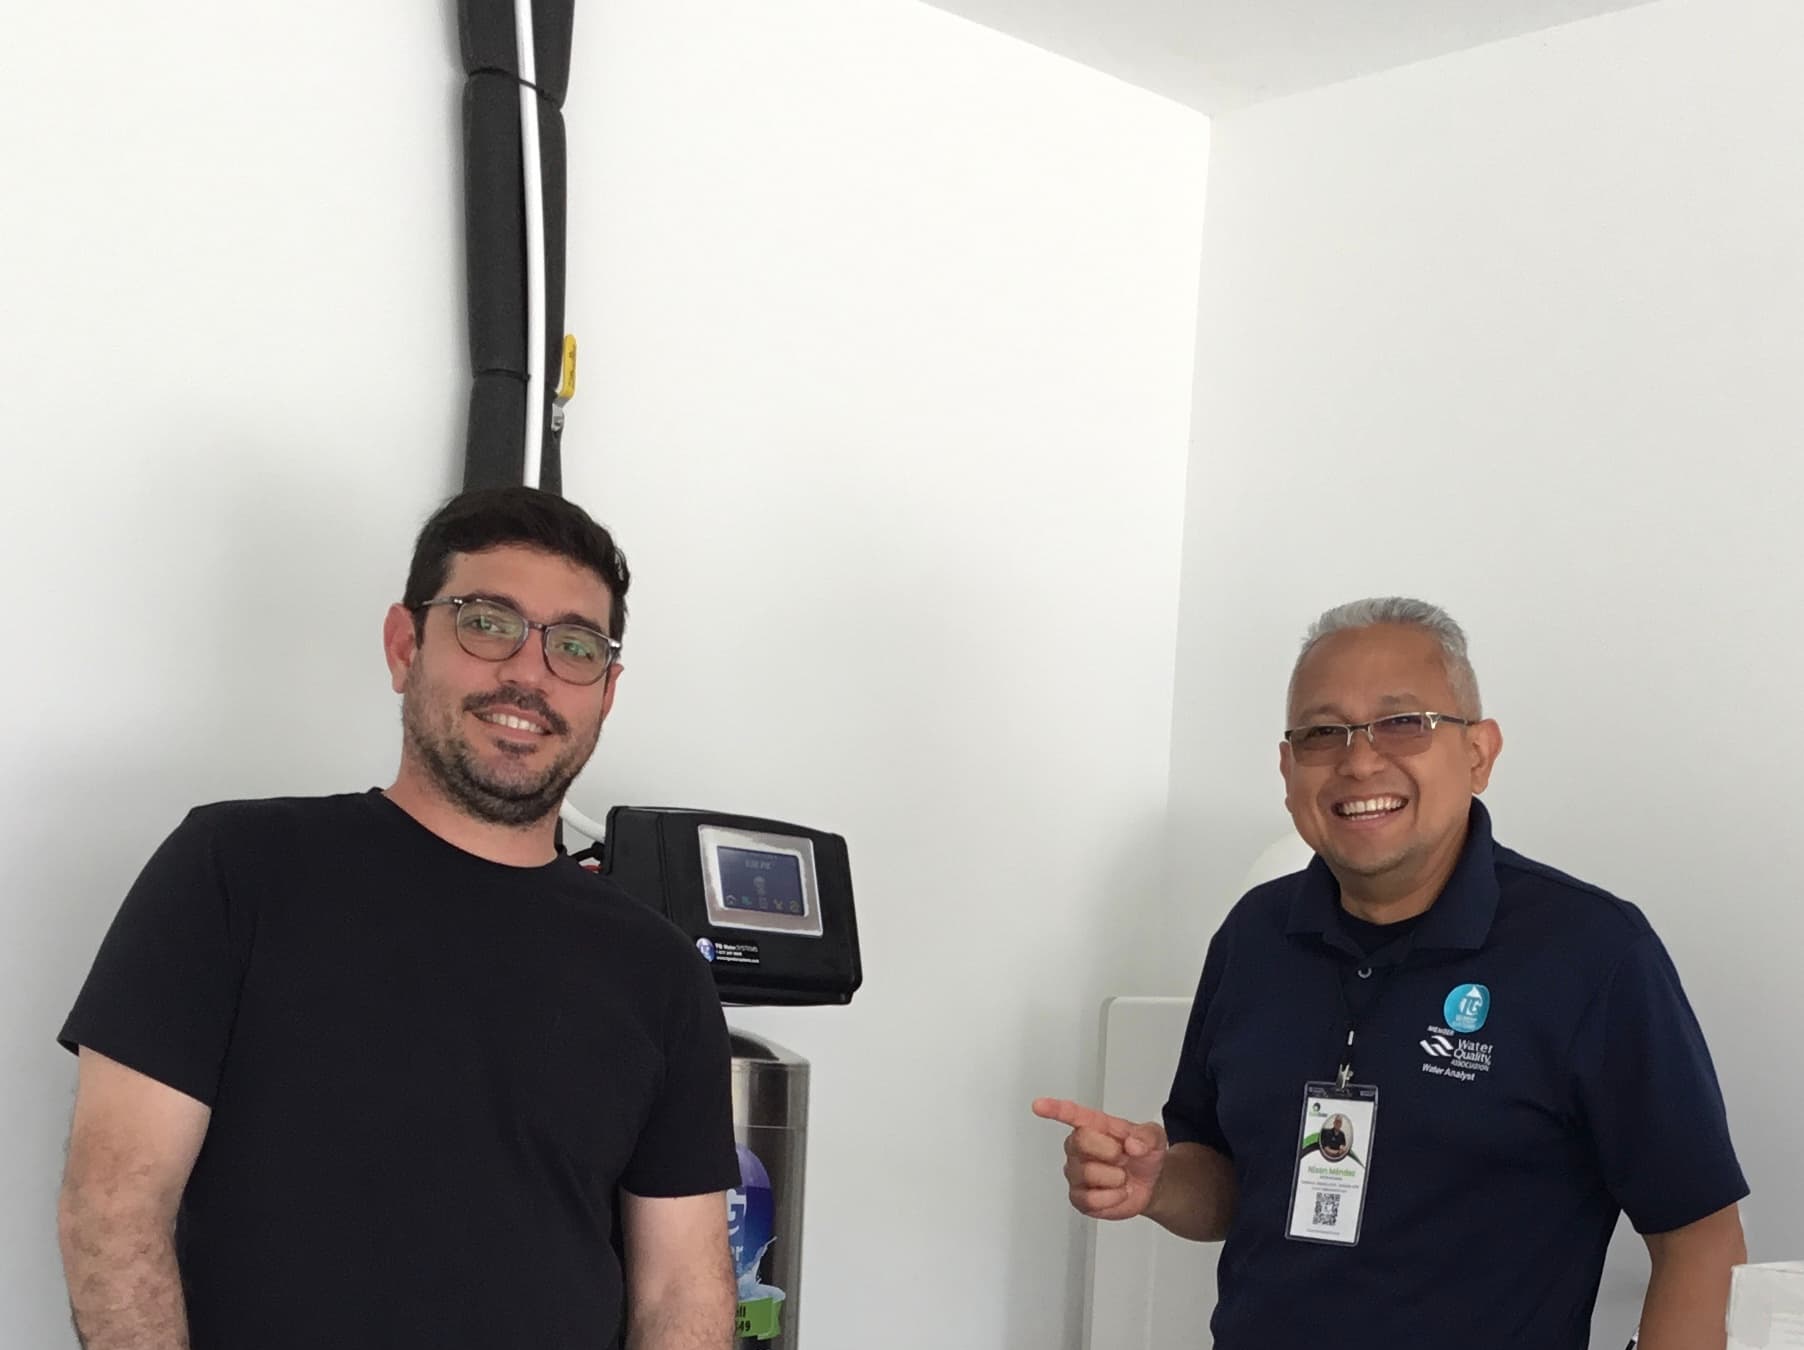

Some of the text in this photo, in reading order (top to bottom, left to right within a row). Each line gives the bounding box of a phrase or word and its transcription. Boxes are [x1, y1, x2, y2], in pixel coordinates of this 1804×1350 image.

[1458, 1039, 1493, 1054] Water
[1453, 1049, 1492, 1066] Quality
[1422, 1063, 1476, 1081] Water Analyst
